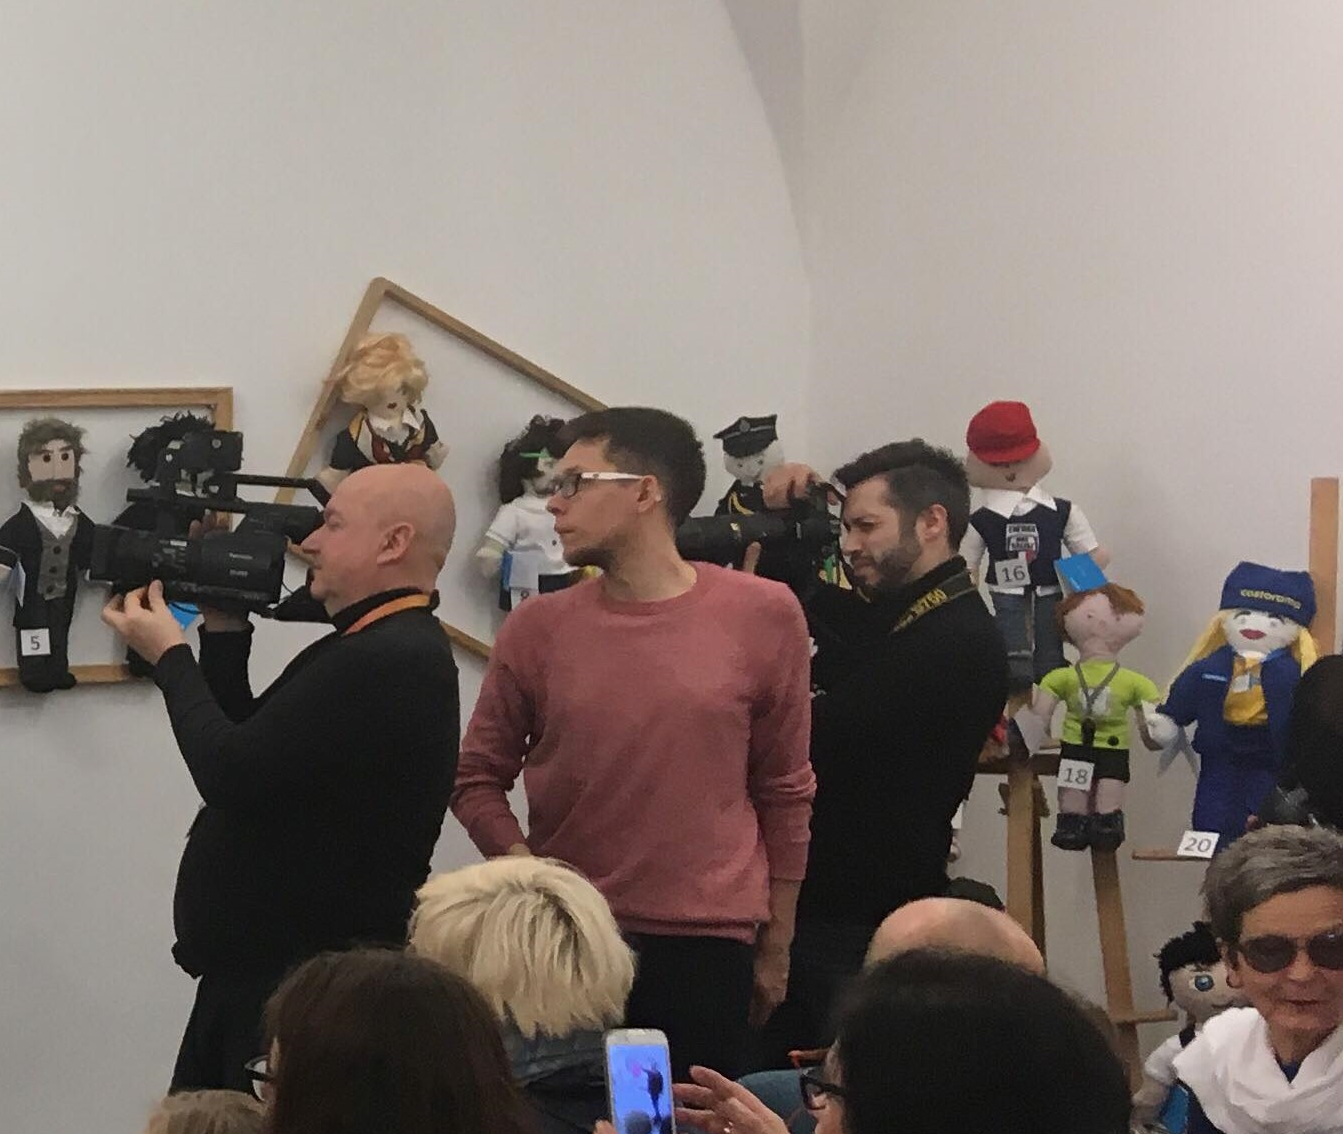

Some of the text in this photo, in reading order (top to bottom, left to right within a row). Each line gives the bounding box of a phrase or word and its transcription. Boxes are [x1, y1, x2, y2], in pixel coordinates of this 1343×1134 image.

[1002, 565, 1026, 583] 16
[30, 635, 41, 651] 5
[1063, 767, 1089, 785] 18
[1184, 837, 1212, 853] 20
